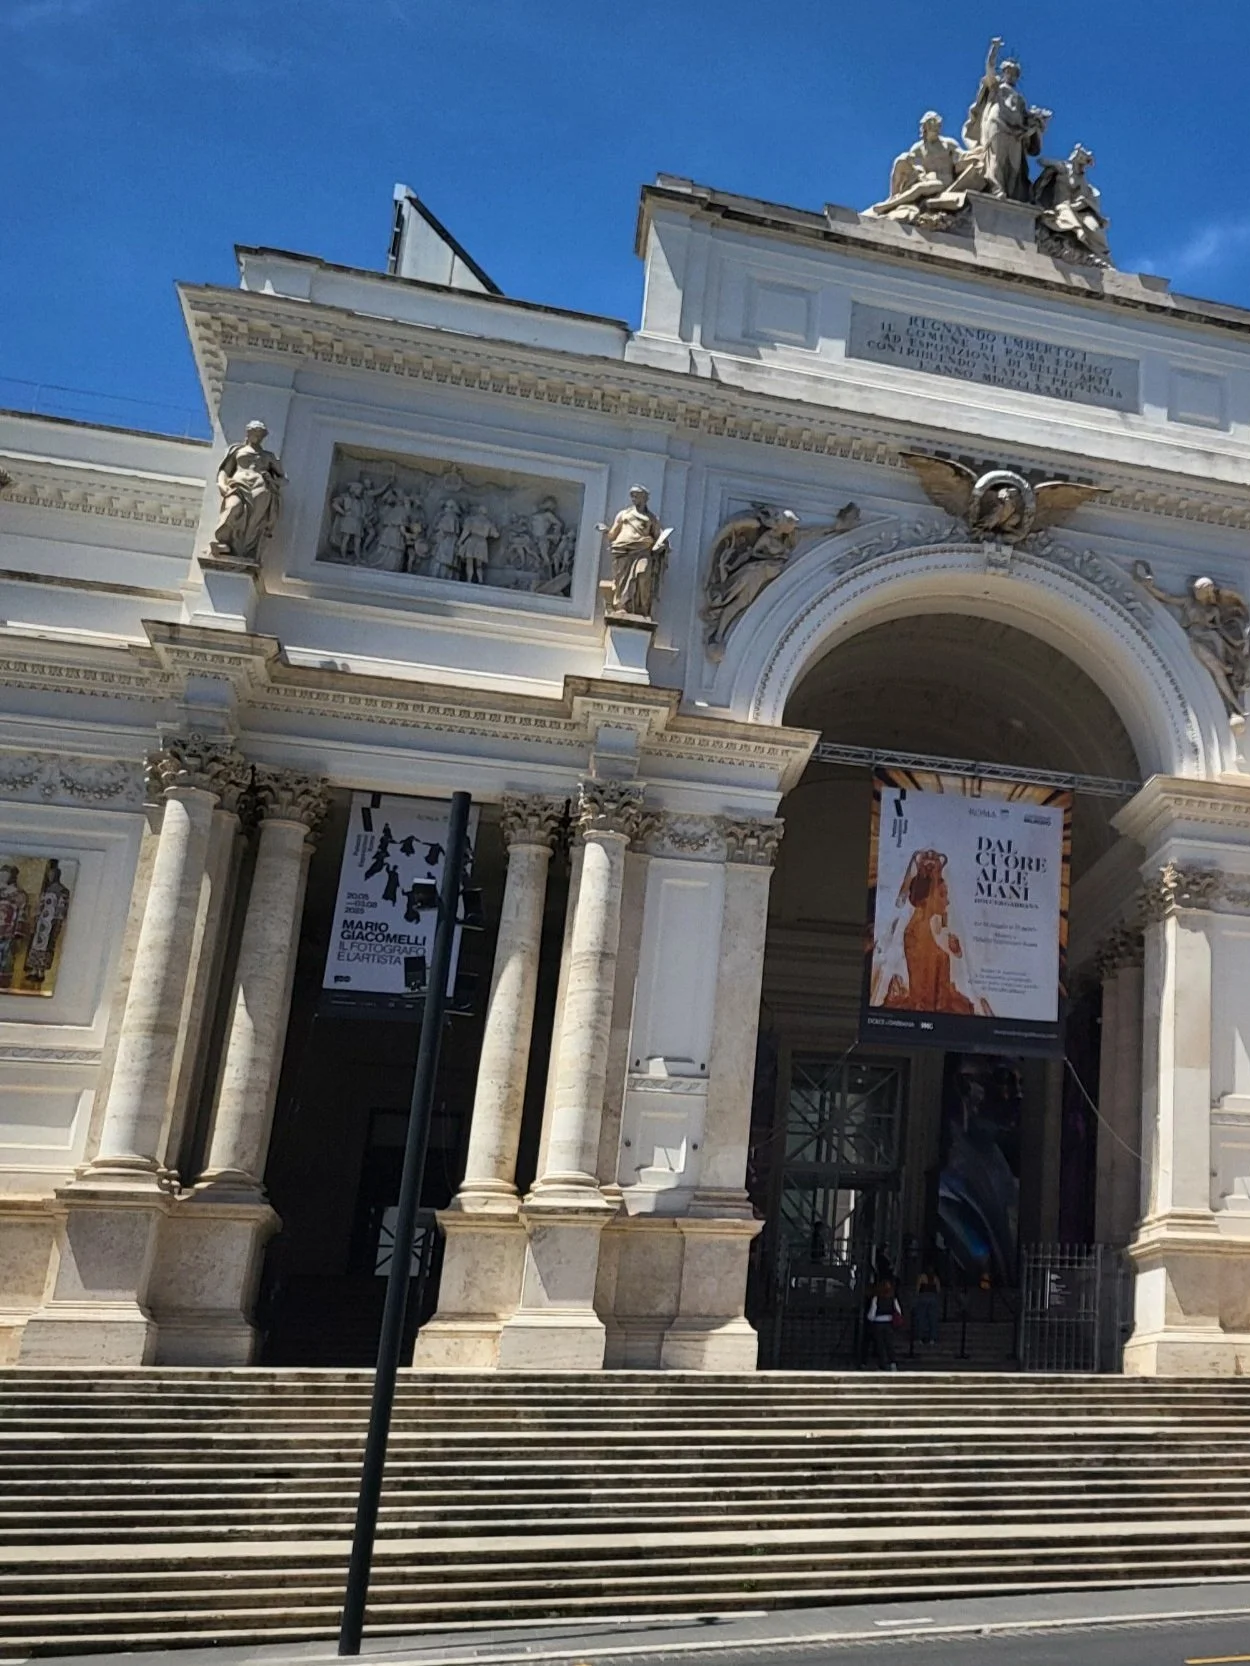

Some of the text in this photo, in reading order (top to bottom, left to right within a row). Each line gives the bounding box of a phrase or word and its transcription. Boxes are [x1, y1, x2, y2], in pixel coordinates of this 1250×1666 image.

[884, 332, 901, 344] AD
[906, 327, 966, 348] COMUNE
[1005, 347, 1045, 364] ROMA
[909, 316, 997, 343] REGNANDO
[1003, 335, 1076, 360] UMBERTO
[977, 835, 1018, 856] DAL
[975, 851, 1048, 874] CUORE
[976, 867, 1029, 887] ALLE
[974, 881, 1029, 902] MANI
[342, 919, 390, 933] MARIO
[340, 929, 427, 947] GIACOMELLI
[337, 951, 345, 962] E
[338, 941, 427, 957] IL FOTOGRAFO
